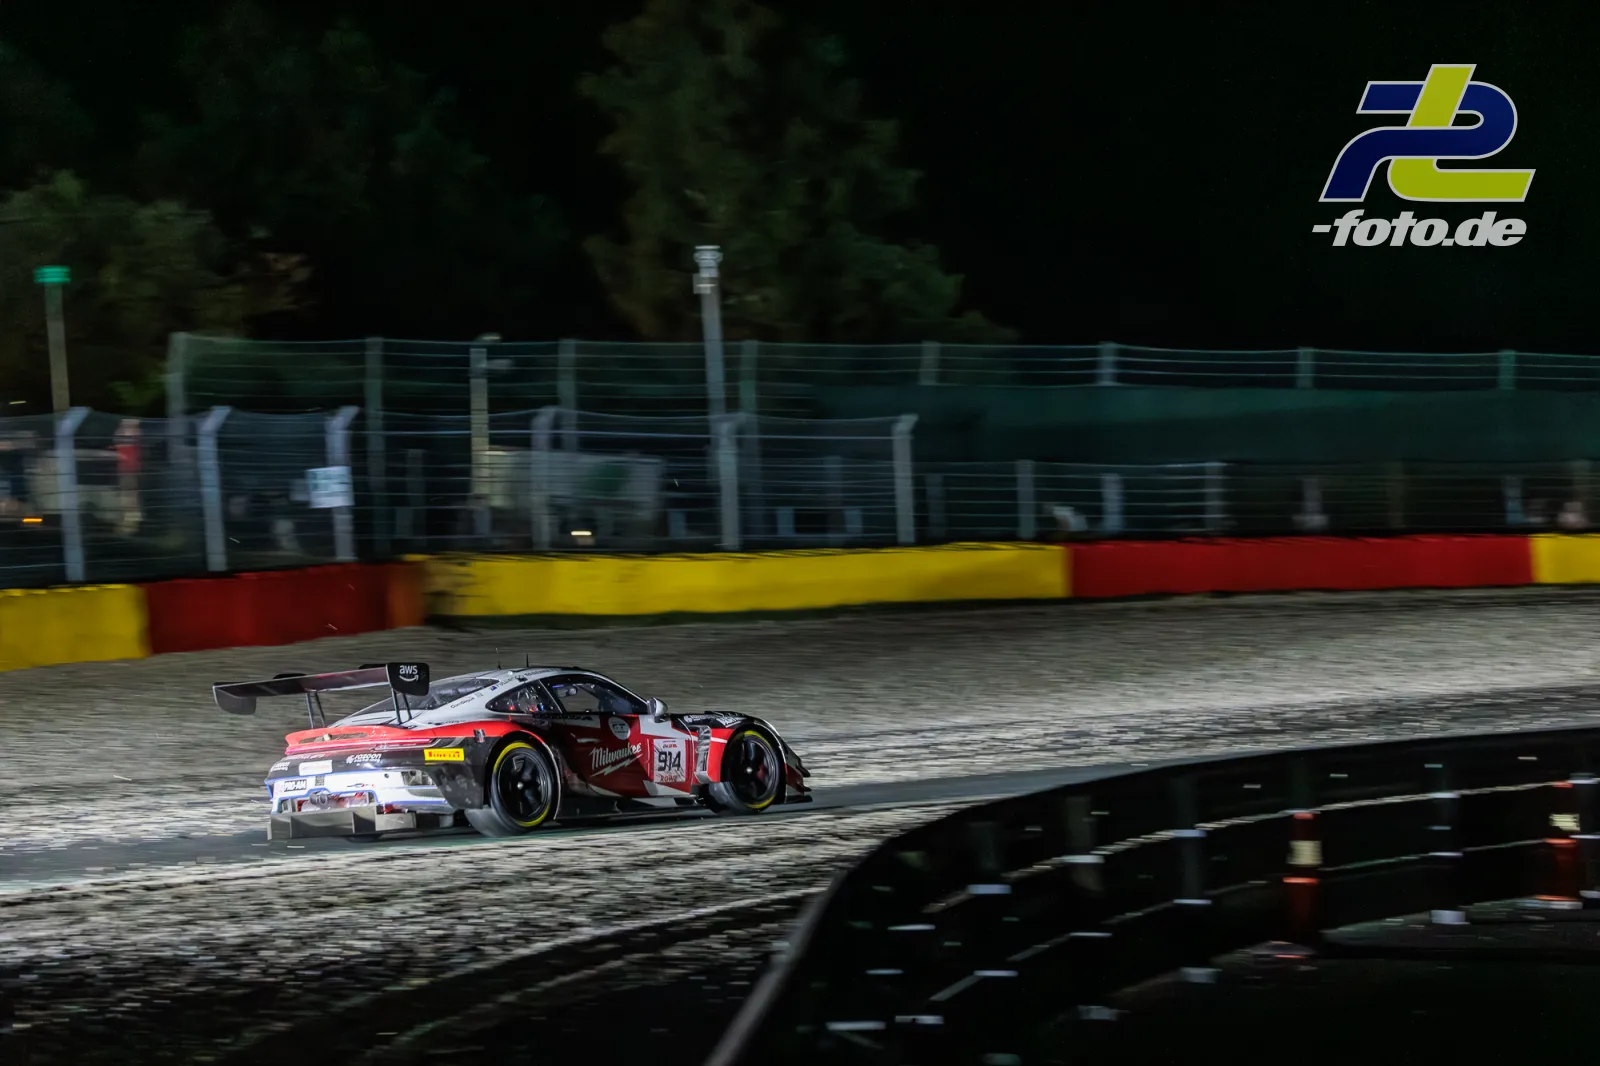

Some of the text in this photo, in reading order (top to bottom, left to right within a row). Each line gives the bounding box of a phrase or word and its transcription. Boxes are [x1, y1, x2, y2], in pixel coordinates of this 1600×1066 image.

[399, 665, 418, 675] aws
[589, 742, 642, 770] Milwaukee
[657, 750, 682, 772] 914
